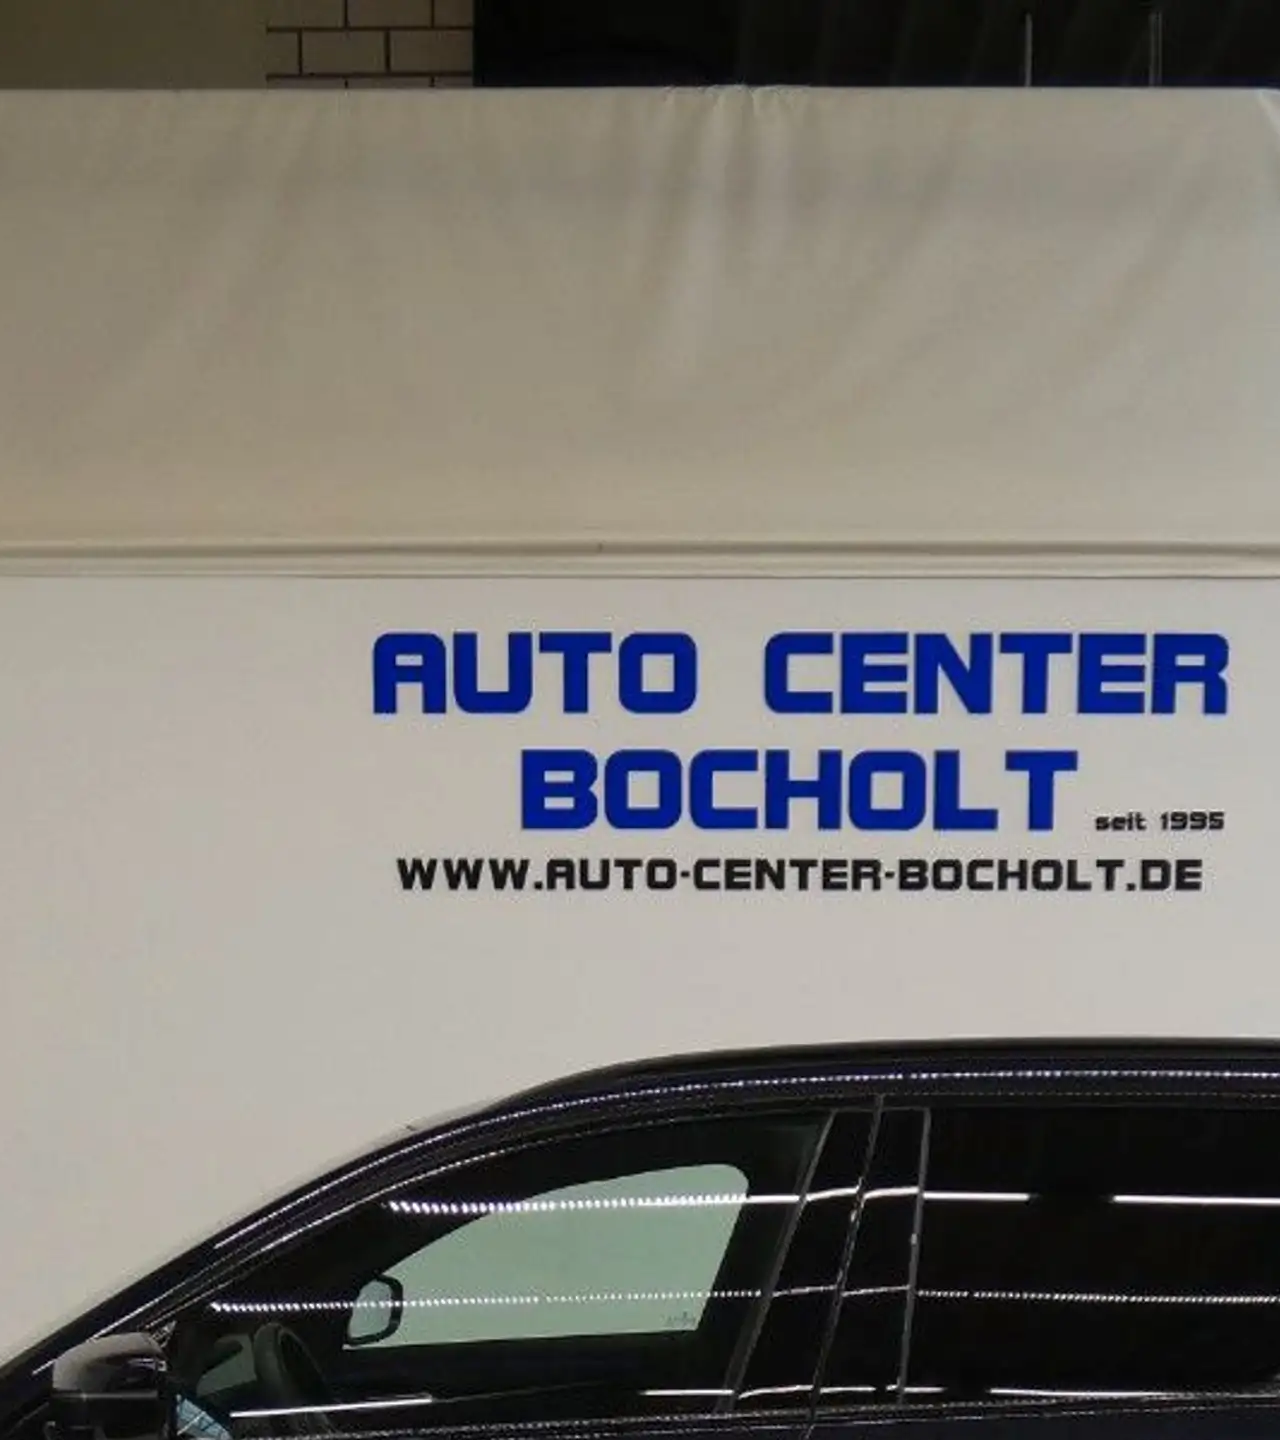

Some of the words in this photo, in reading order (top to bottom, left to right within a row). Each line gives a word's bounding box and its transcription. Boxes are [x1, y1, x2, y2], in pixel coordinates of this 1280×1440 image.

[372, 631, 698, 715] AUTO
[763, 631, 1230, 715] CENTER
[521, 749, 1078, 831] BOCHOLT
[1095, 812, 1146, 831] seit
[1161, 811, 1225, 831] 1995
[397, 857, 1203, 892] WWW.AUTO-CENTER-BOCHOLT.DE
